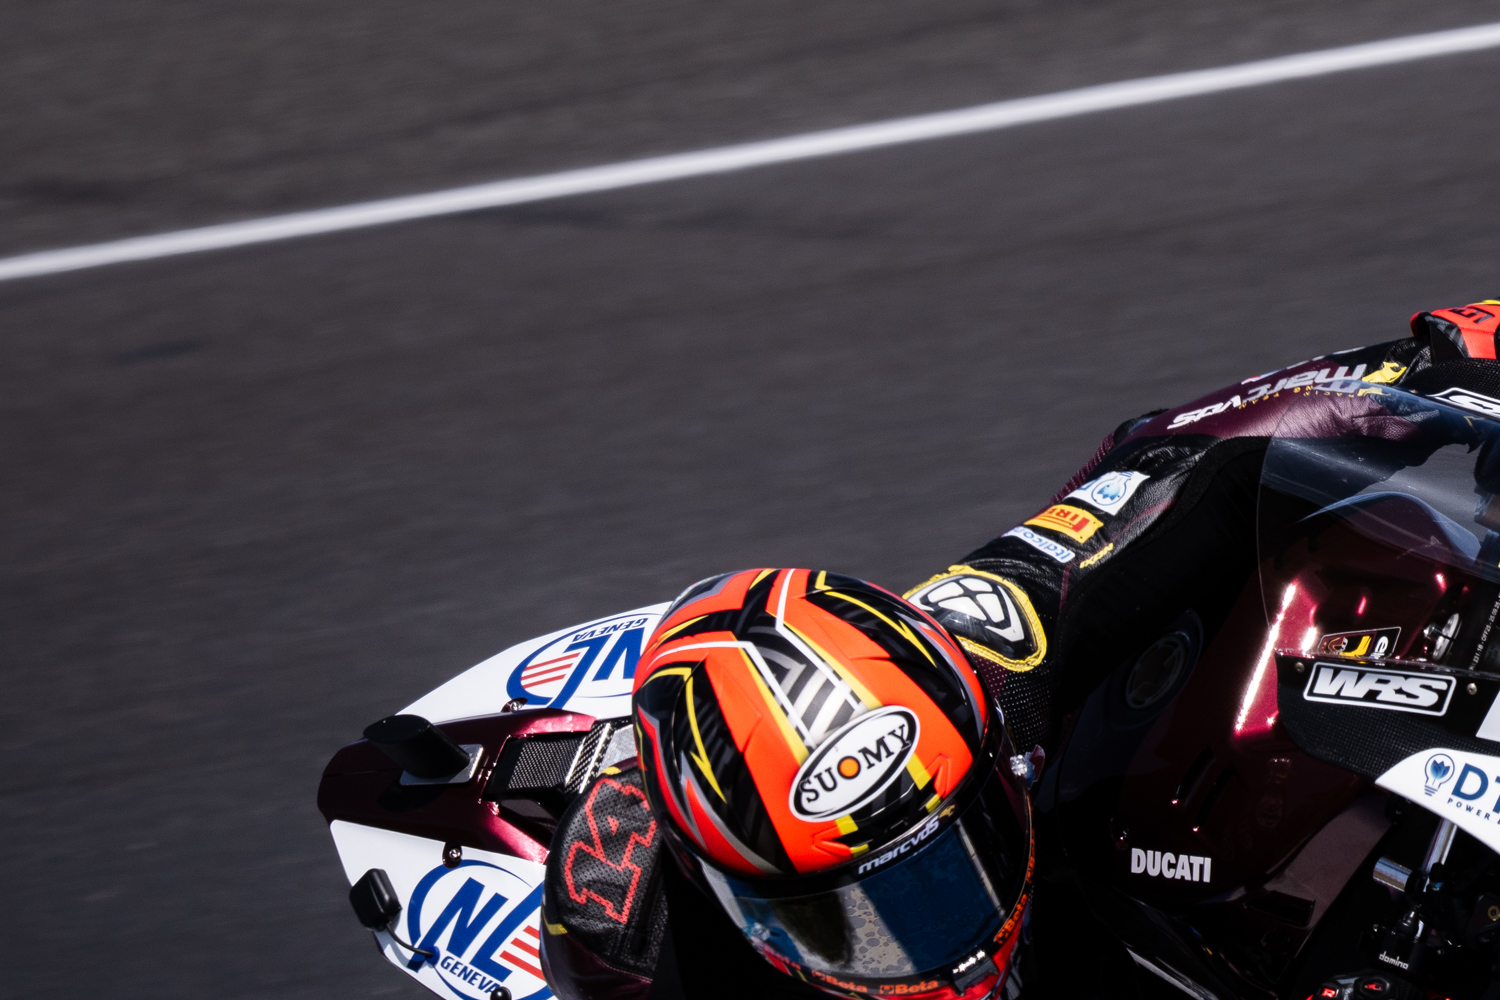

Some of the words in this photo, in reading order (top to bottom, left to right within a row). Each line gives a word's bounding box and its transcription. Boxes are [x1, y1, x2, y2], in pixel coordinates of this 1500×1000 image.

[572, 618, 648, 642] GENEVA
[1312, 667, 1449, 708] WRS
[799, 724, 912, 803] SUOMY
[1447, 798, 1491, 820] POWER
[564, 777, 658, 925] 14
[1130, 847, 1212, 883] DUCATI
[407, 877, 545, 982] NL
[440, 956, 499, 994] GENEVA
[1378, 950, 1409, 970] domino
[825, 974, 869, 993] Beta
[895, 980, 939, 995] Beta
